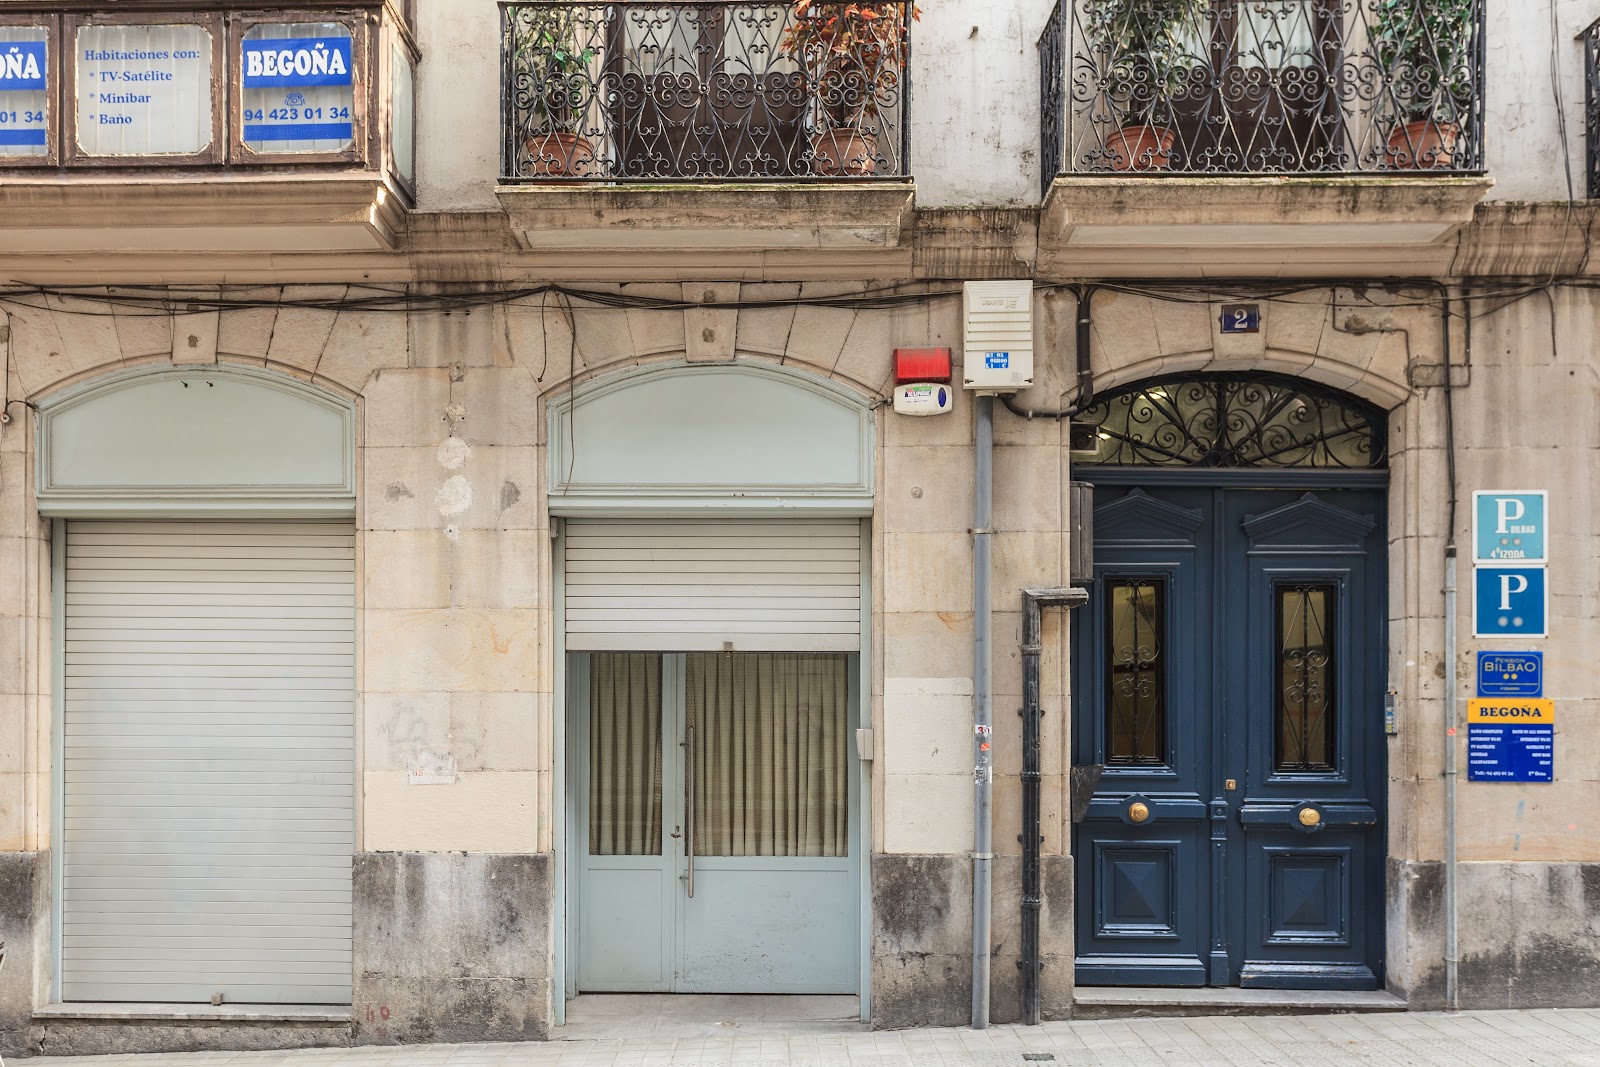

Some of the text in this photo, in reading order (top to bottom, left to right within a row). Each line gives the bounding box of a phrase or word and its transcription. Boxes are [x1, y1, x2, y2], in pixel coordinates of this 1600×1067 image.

[85, 50, 200, 61] Habitaciones con:
[247, 43, 347, 77] BEGOÑA
[99, 70, 173, 82] TV-Satélite
[99, 92, 151, 104] Minibar
[24, 111, 44, 123] 34
[99, 113, 132, 125] Baño
[244, 107, 349, 121] 94 423 01 34
[1234, 309, 1248, 329] 2
[1494, 498, 1525, 534] P
[1510, 525, 1536, 534] BILBAO
[1498, 574, 1528, 610] P
[1484, 661, 1537, 673] BILBAO
[1480, 704, 1542, 717] BEGOÑA
